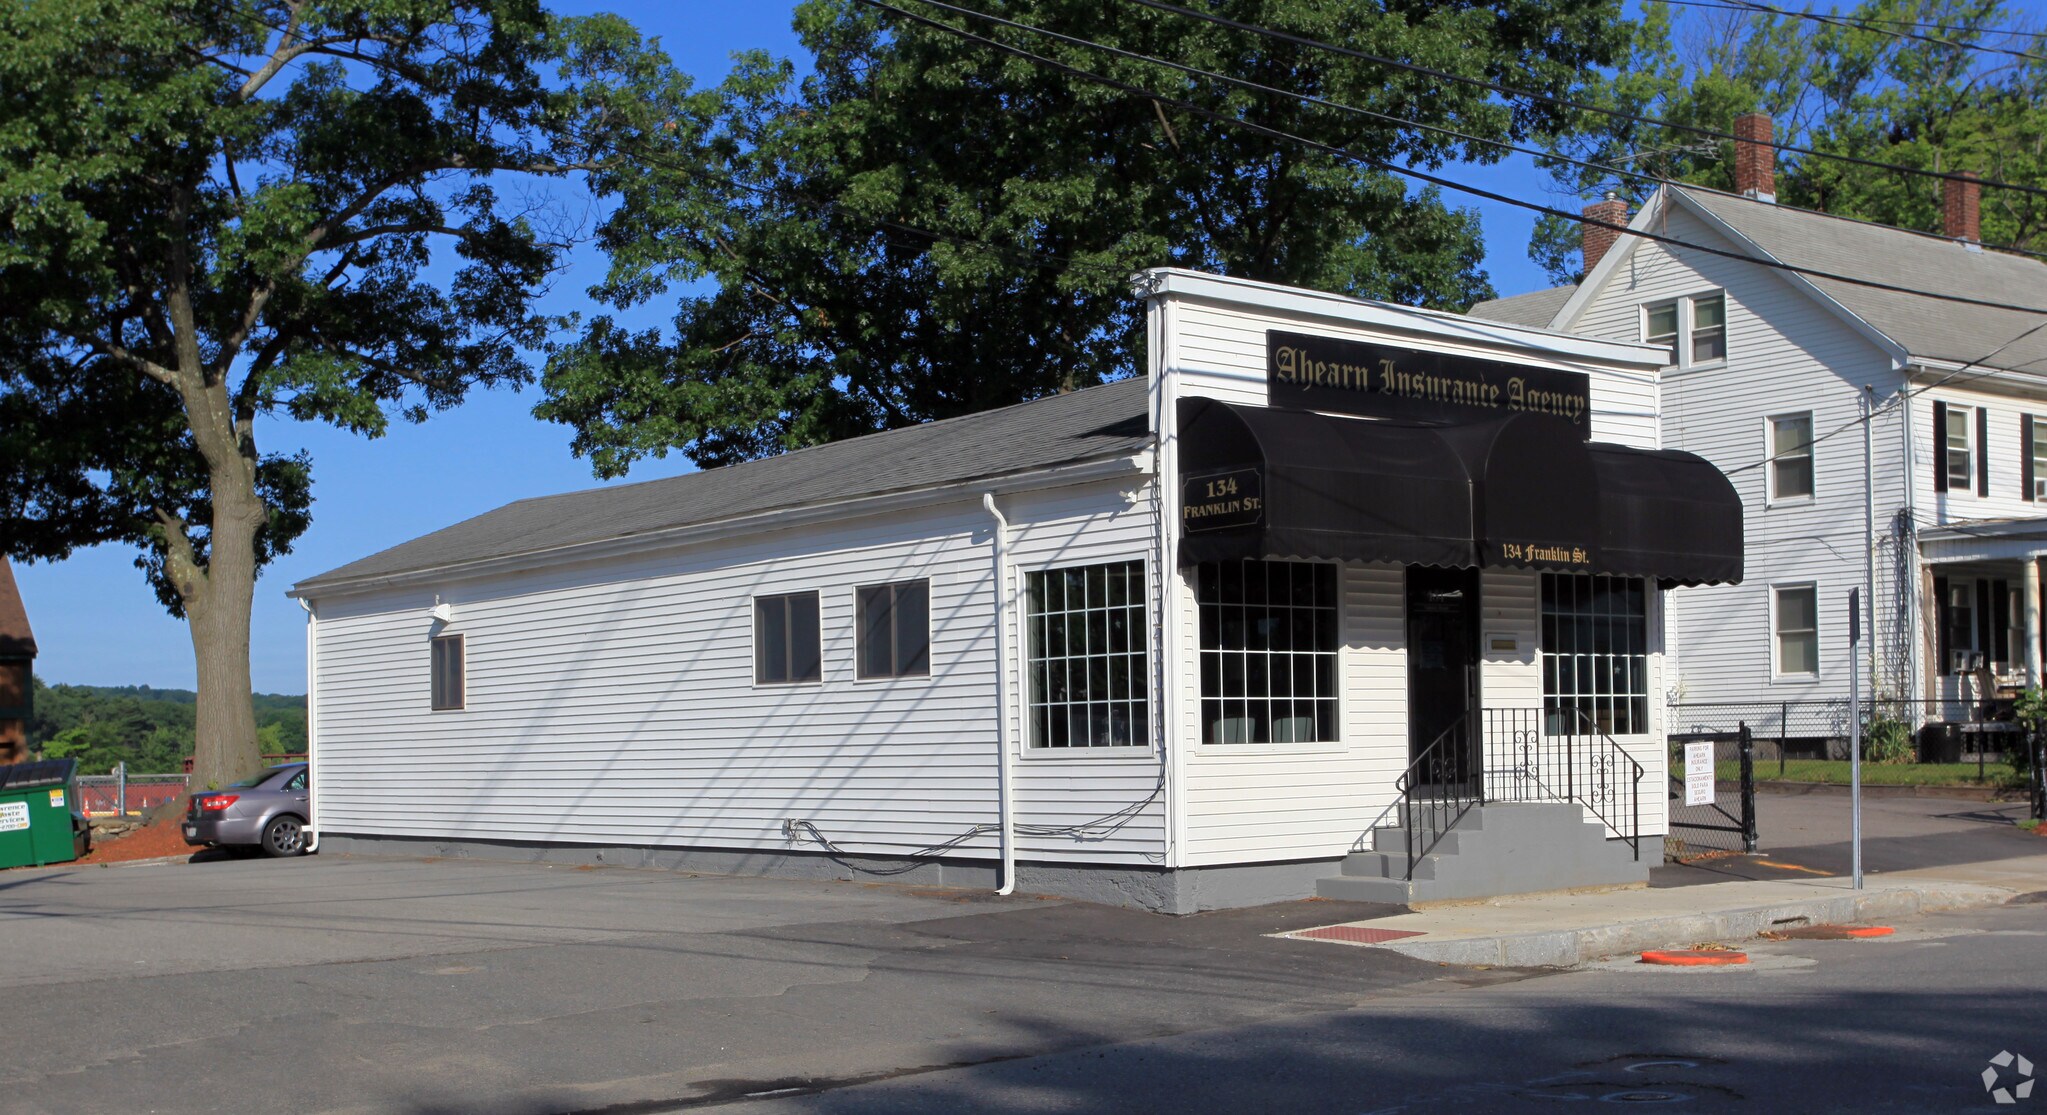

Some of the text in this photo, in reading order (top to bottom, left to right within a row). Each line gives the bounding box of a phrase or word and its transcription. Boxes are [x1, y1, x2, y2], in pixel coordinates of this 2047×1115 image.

[1275, 346, 1585, 425] Ahearn Insurance Agency
[1206, 477, 1239, 498] 134
[1183, 497, 1262, 519] FRANKLIN ST.
[1503, 543, 1590, 563] 134 Franklin St.
